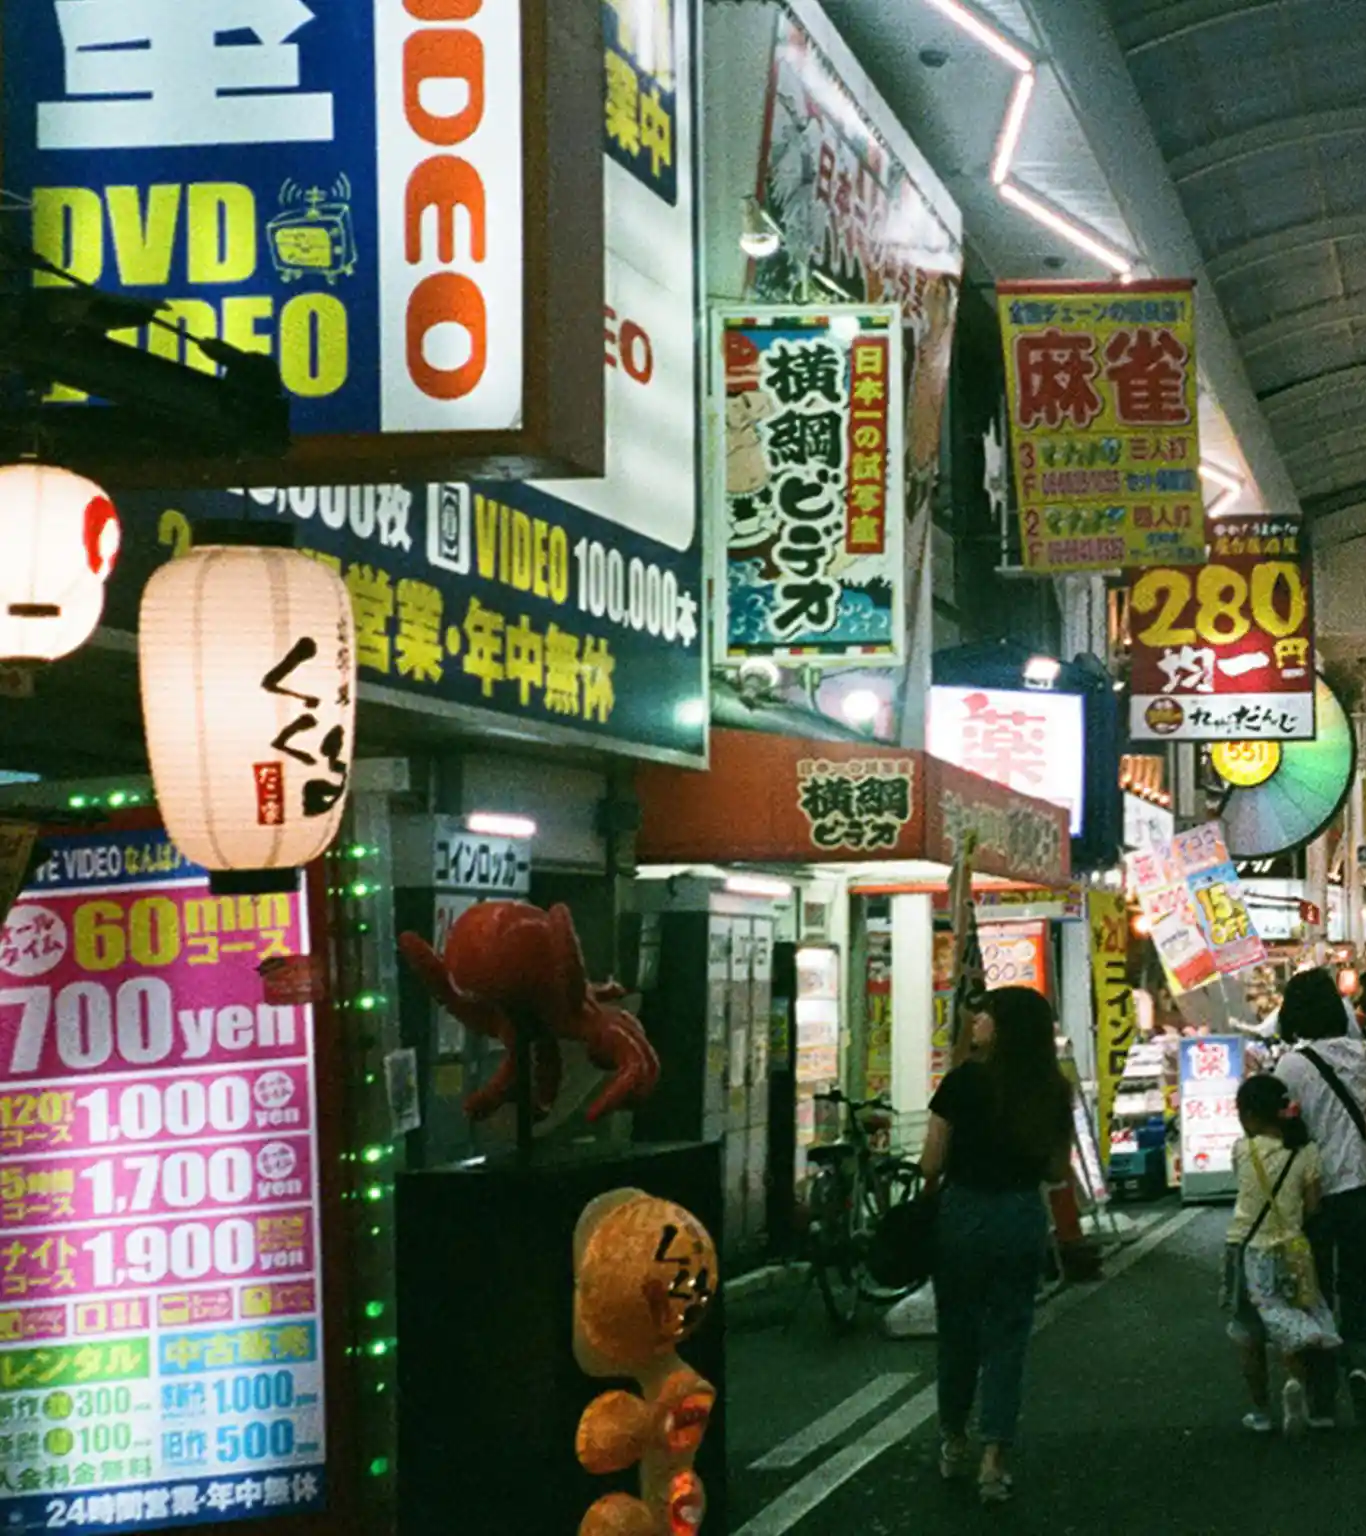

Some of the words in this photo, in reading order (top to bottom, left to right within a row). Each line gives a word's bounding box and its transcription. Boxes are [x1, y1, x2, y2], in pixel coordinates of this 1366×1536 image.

[31, 183, 257, 288] DVD
[1013, 328, 1190, 428] 麻雀
[852, 342, 885, 546] 日本一の試写室
[763, 342, 844, 640] 横綱ビデオ
[474, 493, 567, 605] VIDEO
[574, 539, 698, 648] 100,000本
[1131, 560, 1307, 649] 280
[1157, 645, 1271, 693] 均一
[1273, 637, 1309, 669] 円
[802, 776, 911, 820] 横綱
[813, 819, 900, 848] ビデオ
[63, 844, 122, 880] VIDEO
[436, 840, 529, 887] コインロッカー
[72, 894, 183, 972] 60
[186, 930, 292, 966] コース
[0, 975, 174, 1074] 700
[178, 1003, 297, 1060] yen
[76, 1075, 251, 1144] 1,000
[254, 1106, 300, 1127] yen
[78, 1146, 254, 1215] 1,700
[256, 1177, 302, 1200] yen
[2, 1235, 78, 1273] ナイト
[80, 1217, 256, 1288] 1,900
[258, 1249, 305, 1270] yen
[4, 1269, 78, 1295] コース
[0, 1346, 142, 1385] レンタル
[76, 1384, 133, 1417] 300
[79, 1420, 133, 1455] 100
[216, 1418, 295, 1463] 500
[46, 1473, 319, 1530] 24時間営業・年中無休
